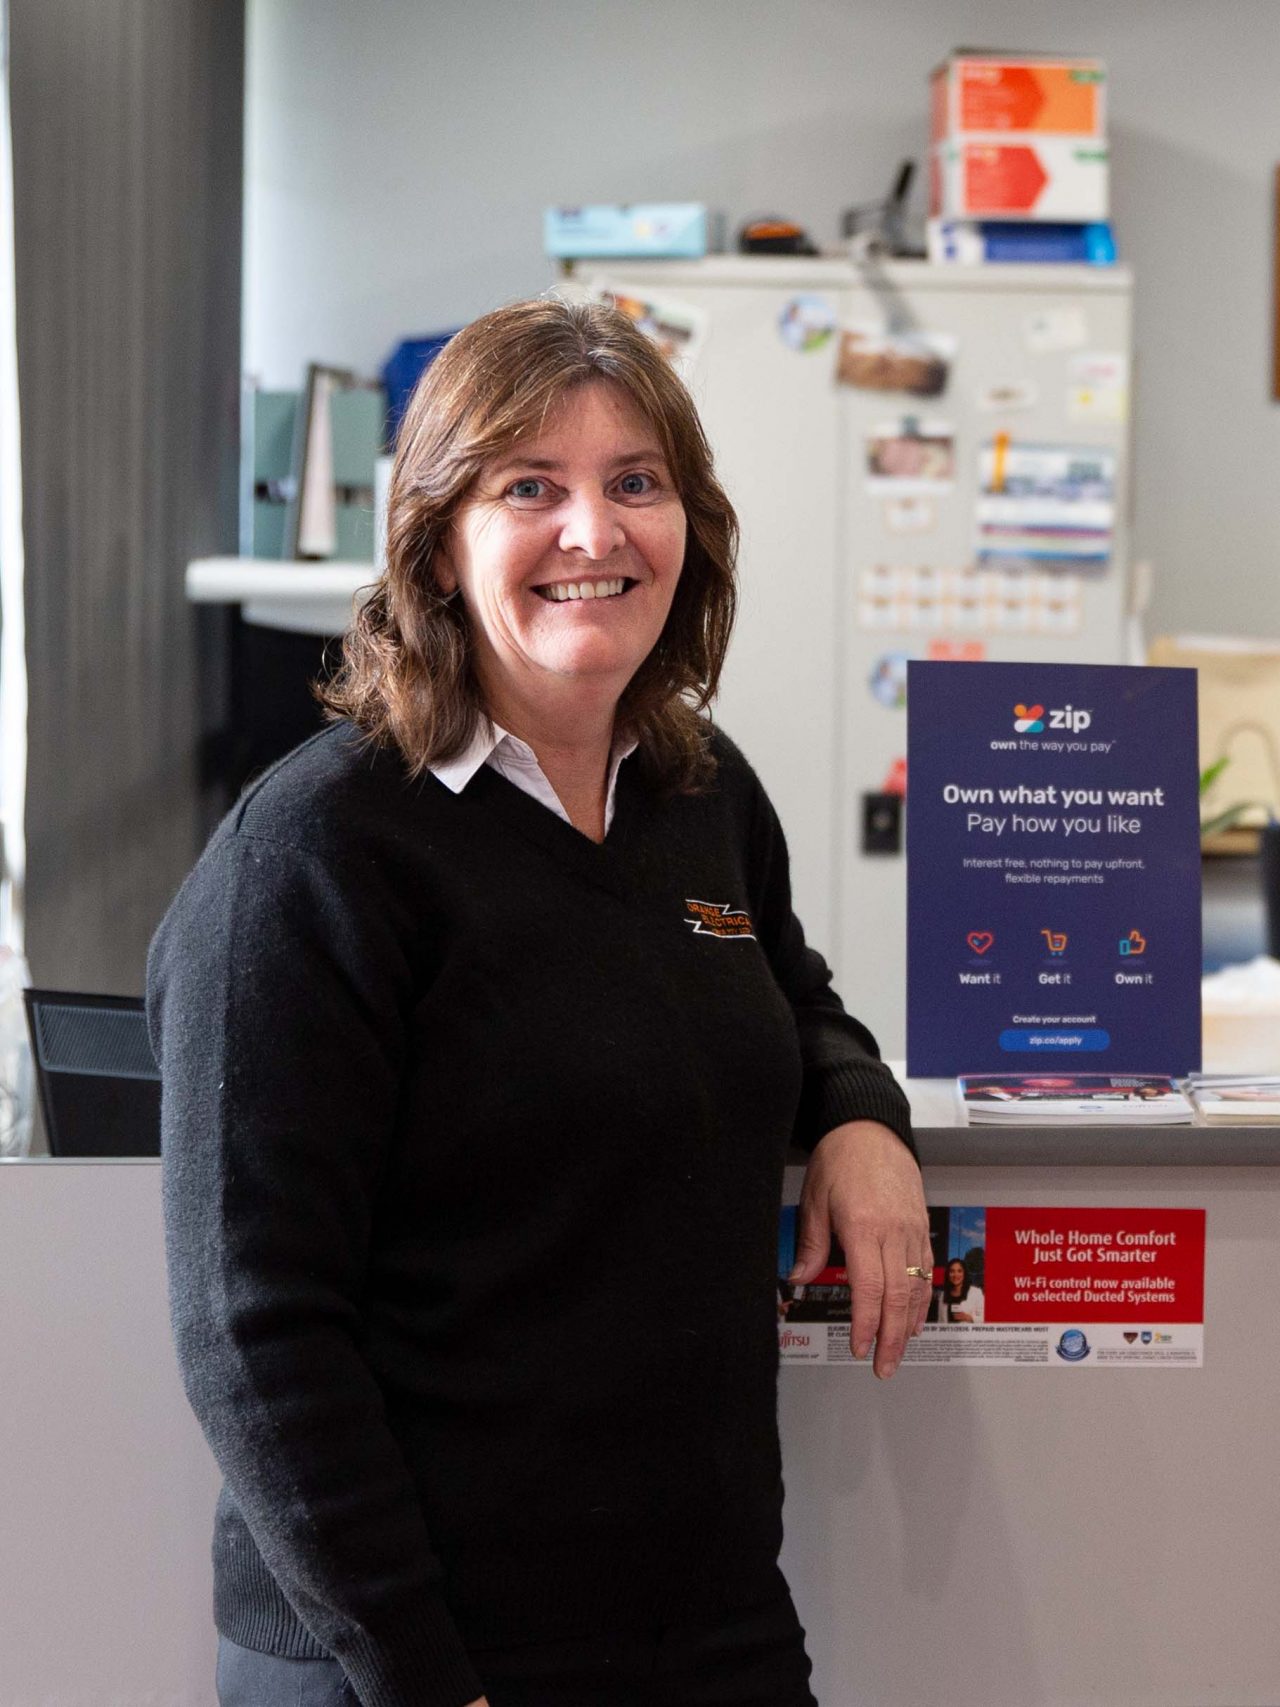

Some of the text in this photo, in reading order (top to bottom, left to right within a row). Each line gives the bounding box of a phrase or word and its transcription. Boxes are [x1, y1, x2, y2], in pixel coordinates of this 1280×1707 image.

[1049, 705, 1091, 733] zip
[990, 741, 1017, 750] own
[1019, 740, 1038, 751] the
[1041, 742, 1064, 753] way
[1066, 742, 1087, 753] you
[943, 785, 1165, 809] Own what you want
[967, 813, 1142, 837] Pay how you like
[963, 858, 1002, 869] Interest
[1004, 858, 1027, 870] free,
[1030, 858, 1069, 871] nothing
[1071, 859, 1082, 869] to
[1084, 861, 1103, 871] pay
[1005, 873, 1104, 886] flexible repayments
[687, 903, 721, 917] ORANGE
[701, 914, 752, 928] ELECTRIC
[959, 973, 1001, 985] Want it
[1038, 973, 1071, 985] Get it
[1115, 973, 1154, 985] Own it
[1012, 1015, 1096, 1026] Create your account
[1029, 1035, 1083, 1047] zip.co/apply
[1015, 1229, 1177, 1247] Whole Home Comfort
[1032, 1248, 1157, 1264] Just Got Smarter
[1014, 1277, 1175, 1291] Wi-Fi control now available
[1014, 1290, 1176, 1305] on selected Ducted Systems
[779, 1329, 810, 1349] JITSU
